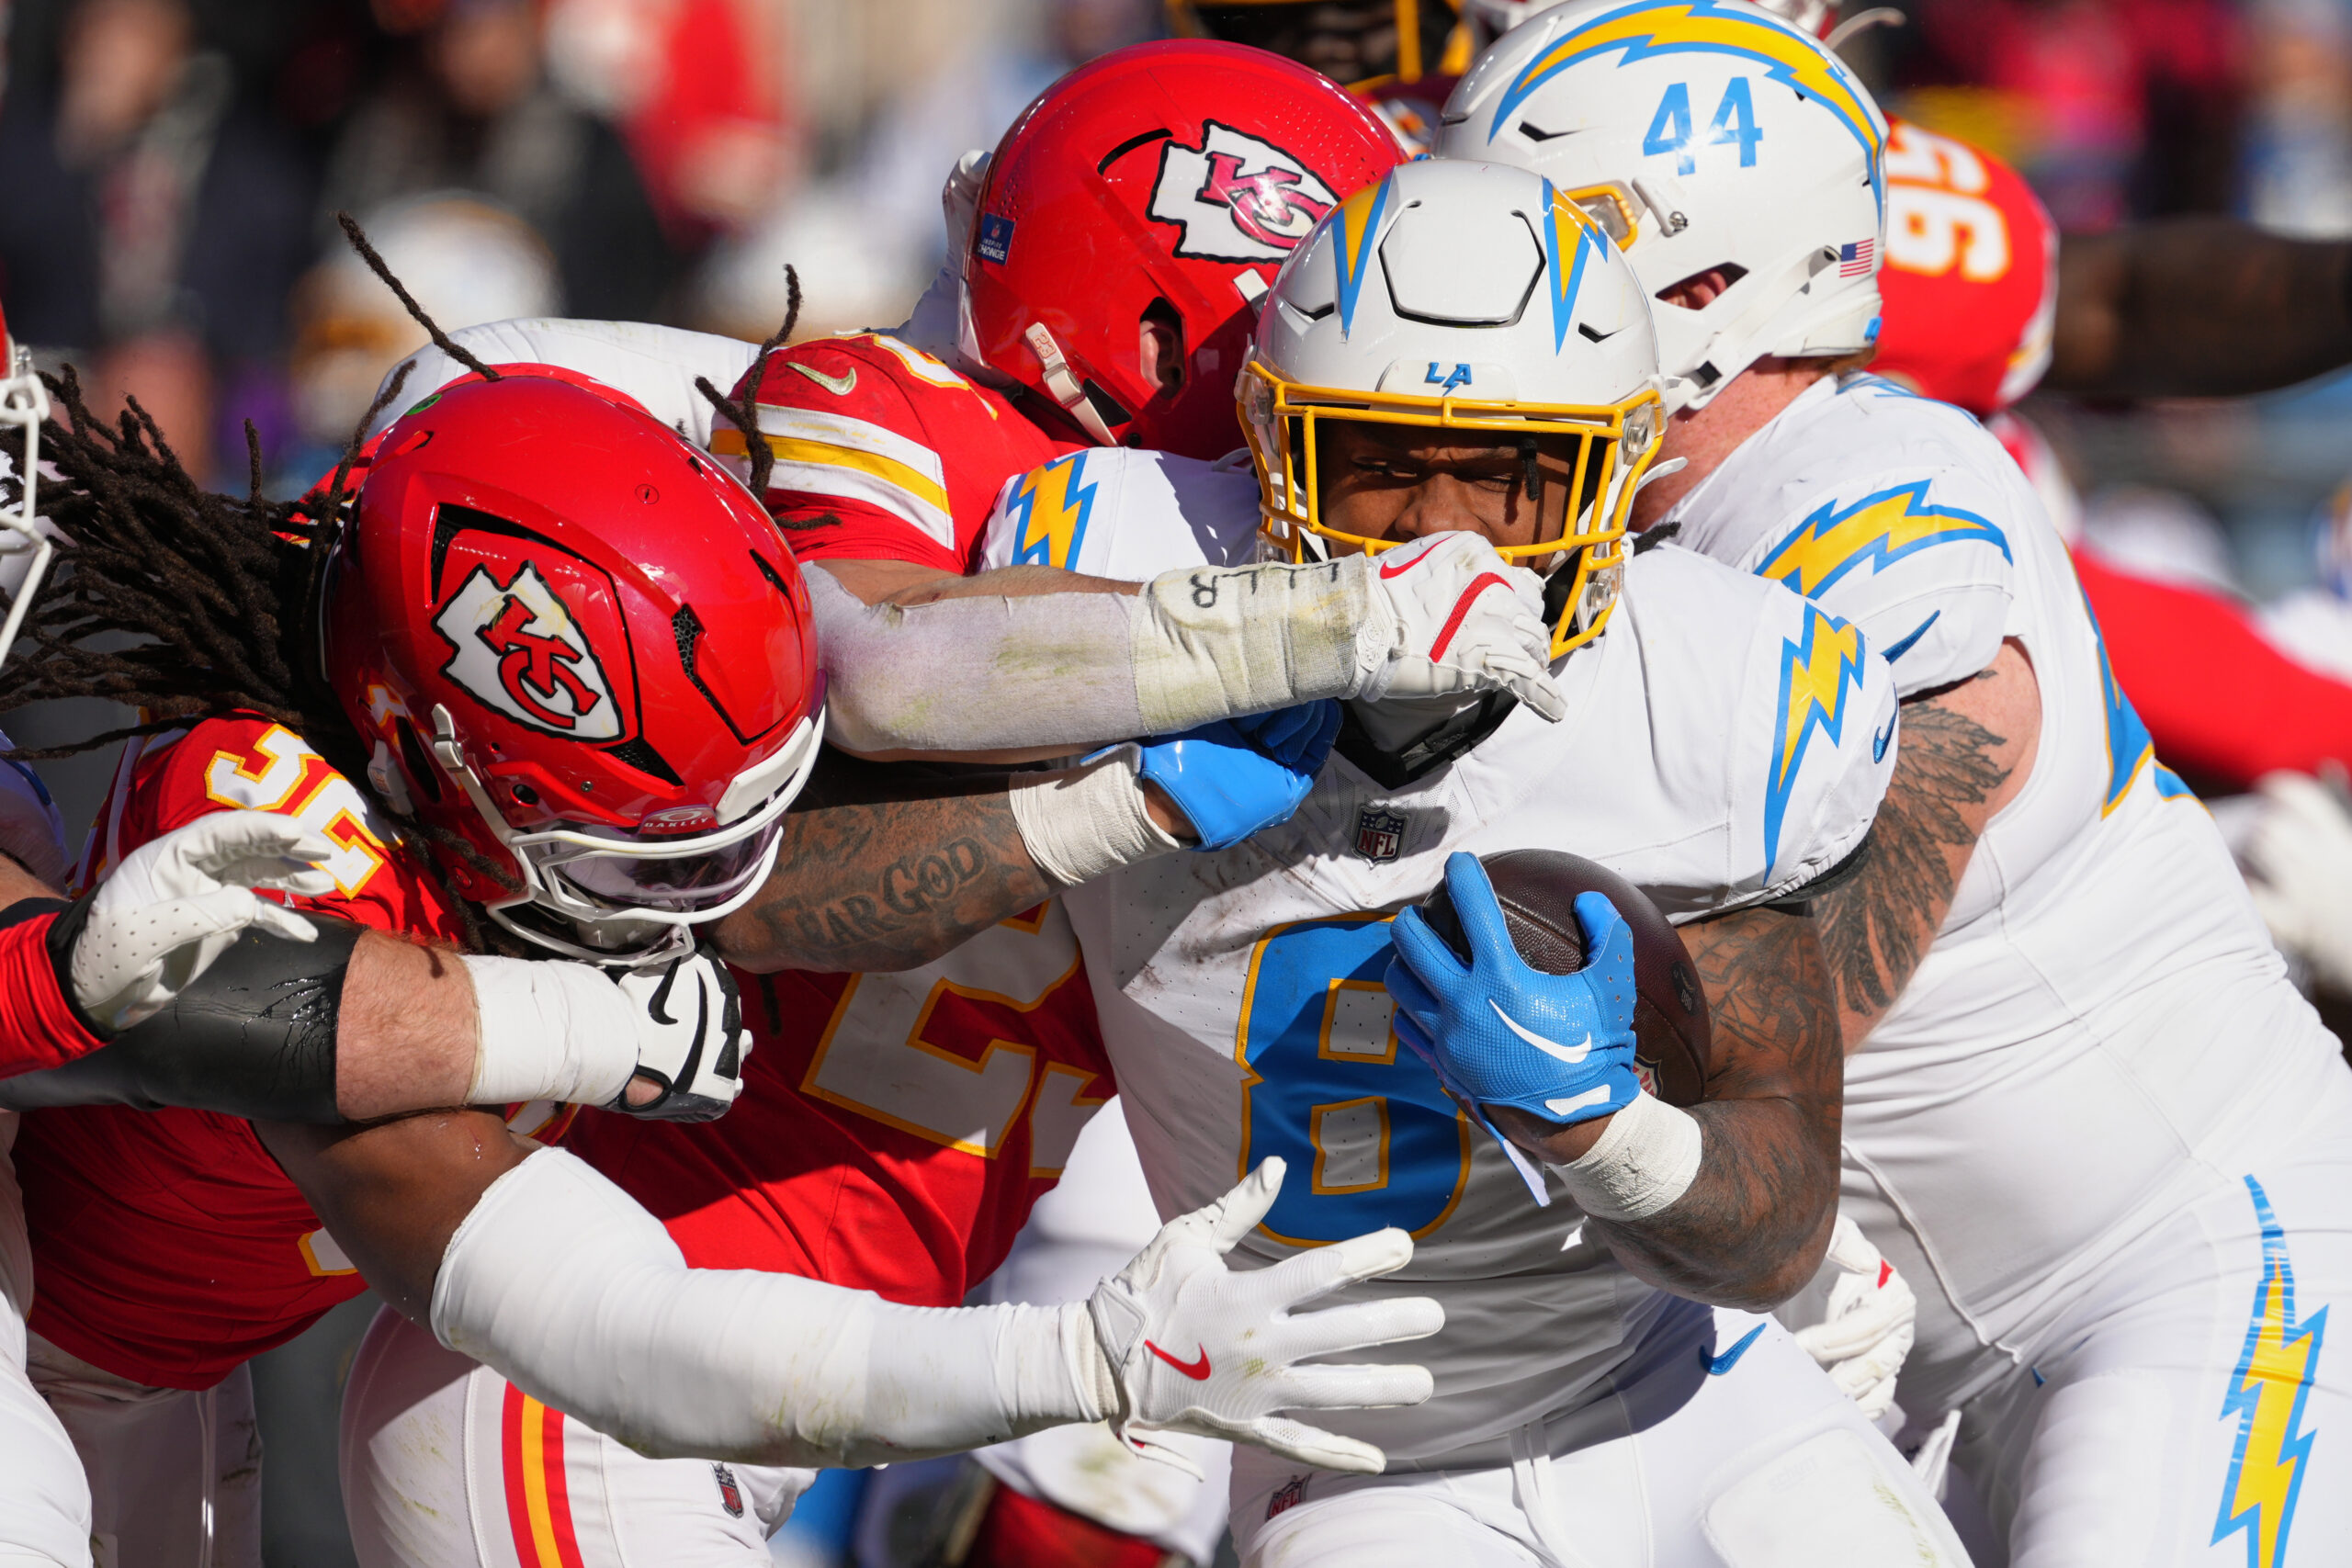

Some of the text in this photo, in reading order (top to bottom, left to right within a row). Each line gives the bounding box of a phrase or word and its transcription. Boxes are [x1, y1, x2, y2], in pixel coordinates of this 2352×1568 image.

[1643, 76, 1763, 176] 44
[1194, 150, 1333, 251] KC
[1032, 332, 1057, 359] 23
[1423, 362, 1472, 397] LA
[474, 593, 603, 731] KC
[644, 817, 709, 828] OAKLEY
[1358, 829, 1396, 857] NFL
[882, 835, 987, 916] GOD
